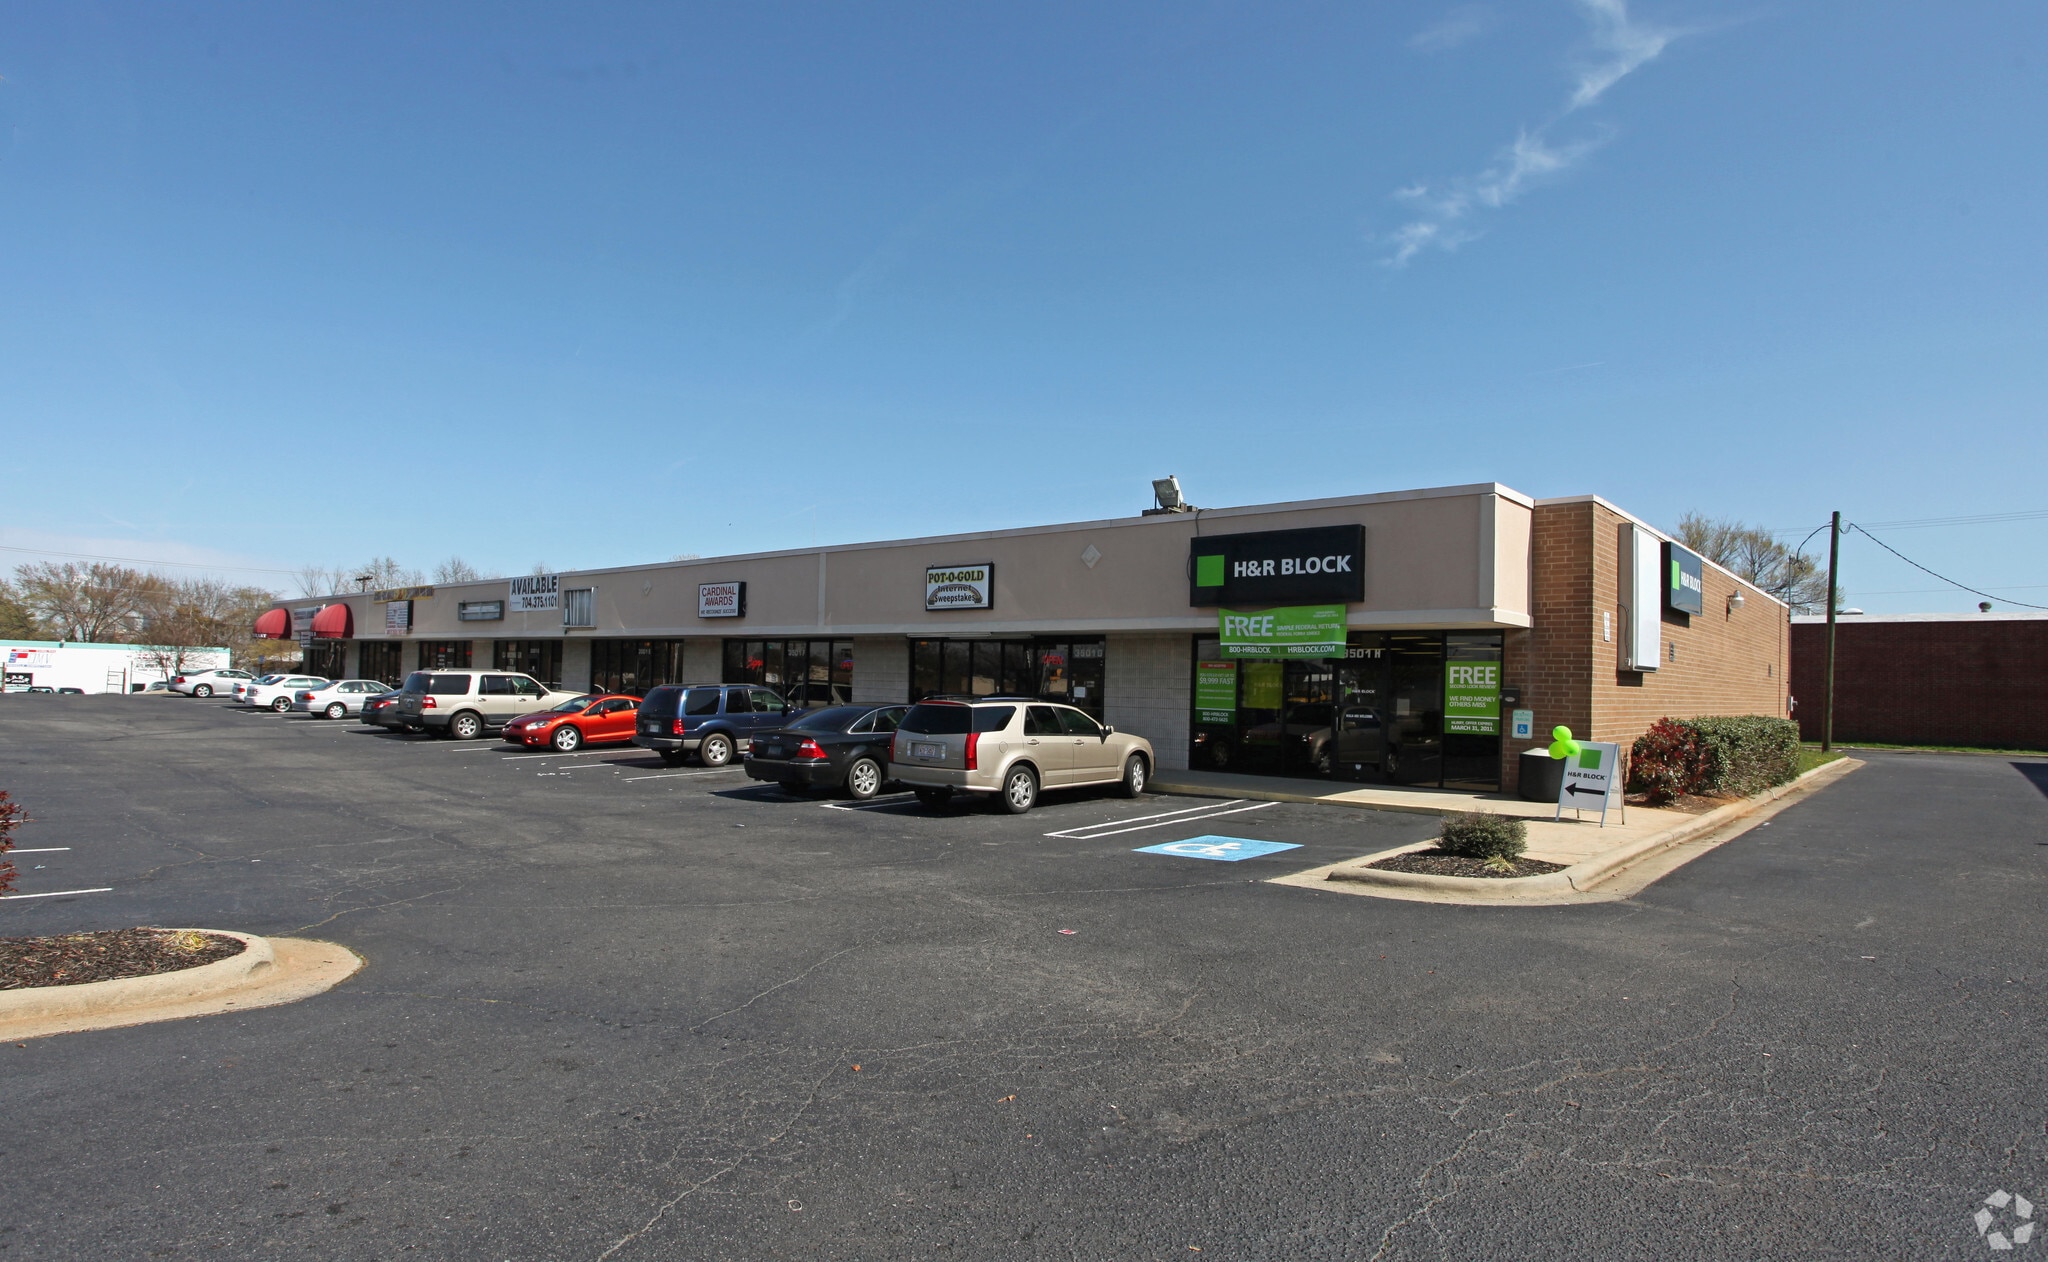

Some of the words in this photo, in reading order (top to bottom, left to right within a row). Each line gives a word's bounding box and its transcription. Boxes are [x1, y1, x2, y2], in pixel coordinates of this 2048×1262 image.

[1234, 559, 1275, 577] H&R
[1281, 555, 1351, 575] BLOCK
[928, 570, 984, 584] POT-O-GOLD
[511, 576, 557, 595] AVAILABLE
[701, 586, 736, 597] CARDINAL
[705, 596, 734, 606] AWARDS
[934, 593, 976, 604] Sweepstakes
[1224, 615, 1274, 637] FREE
[1287, 645, 1336, 653] HRBLOCK.COM
[1219, 677, 1234, 685] FAST
[1449, 666, 1497, 685] FREE
